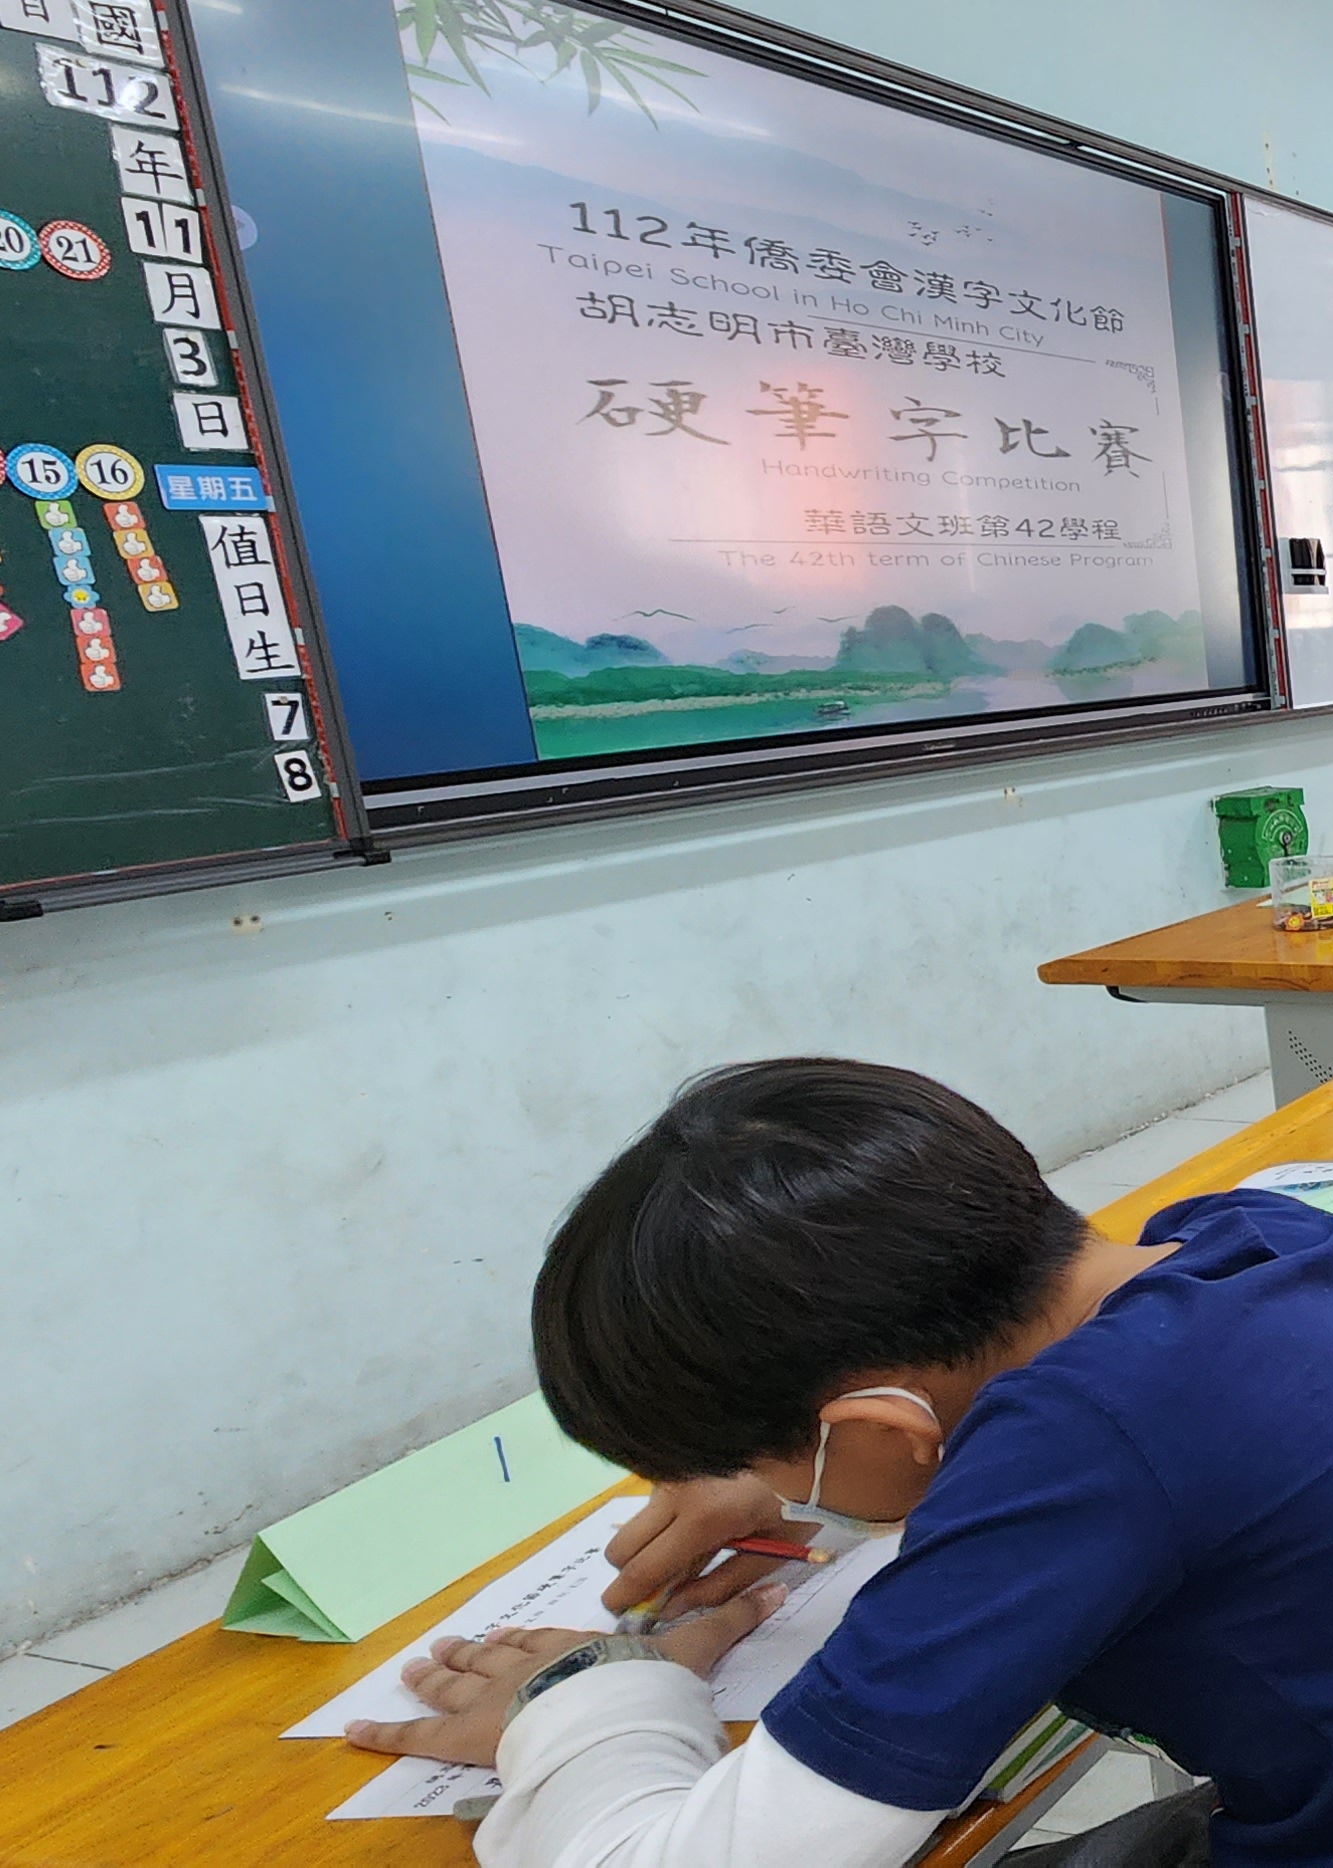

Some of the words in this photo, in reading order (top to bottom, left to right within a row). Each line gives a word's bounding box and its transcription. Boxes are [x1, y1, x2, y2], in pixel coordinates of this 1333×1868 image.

[56, 235, 96, 264] 21
[568, 201, 1126, 335] 112年僑委會漢字文化節
[536, 243, 655, 281] Taipei
[669, 266, 779, 302] School
[792, 288, 819, 307] in
[831, 295, 870, 317] Ho
[881, 303, 923, 327] Chi
[933, 311, 989, 338] Minh
[999, 320, 1045, 347] City
[575, 294, 1006, 379] 胡志明市臺灣學校
[575, 378, 1153, 479] 硬筆字比賽
[21, 459, 61, 485] 15
[89, 458, 128, 486] 16
[168, 475, 257, 502] 星期五
[761, 458, 931, 488] Handwriting
[942, 470, 1082, 495] Competition
[803, 508, 1123, 542] 華語文班第42學程
[718, 549, 776, 568] The
[788, 550, 855, 568] 42th
[867, 552, 931, 568] term
[940, 550, 967, 568] of
[975, 550, 1061, 568] Chinese
[1069, 551, 1154, 570] Program
[211, 525, 296, 674] 值日生
[271, 698, 300, 736] 7
[283, 757, 313, 792] 8
[493, 1435, 511, 1483] 1
